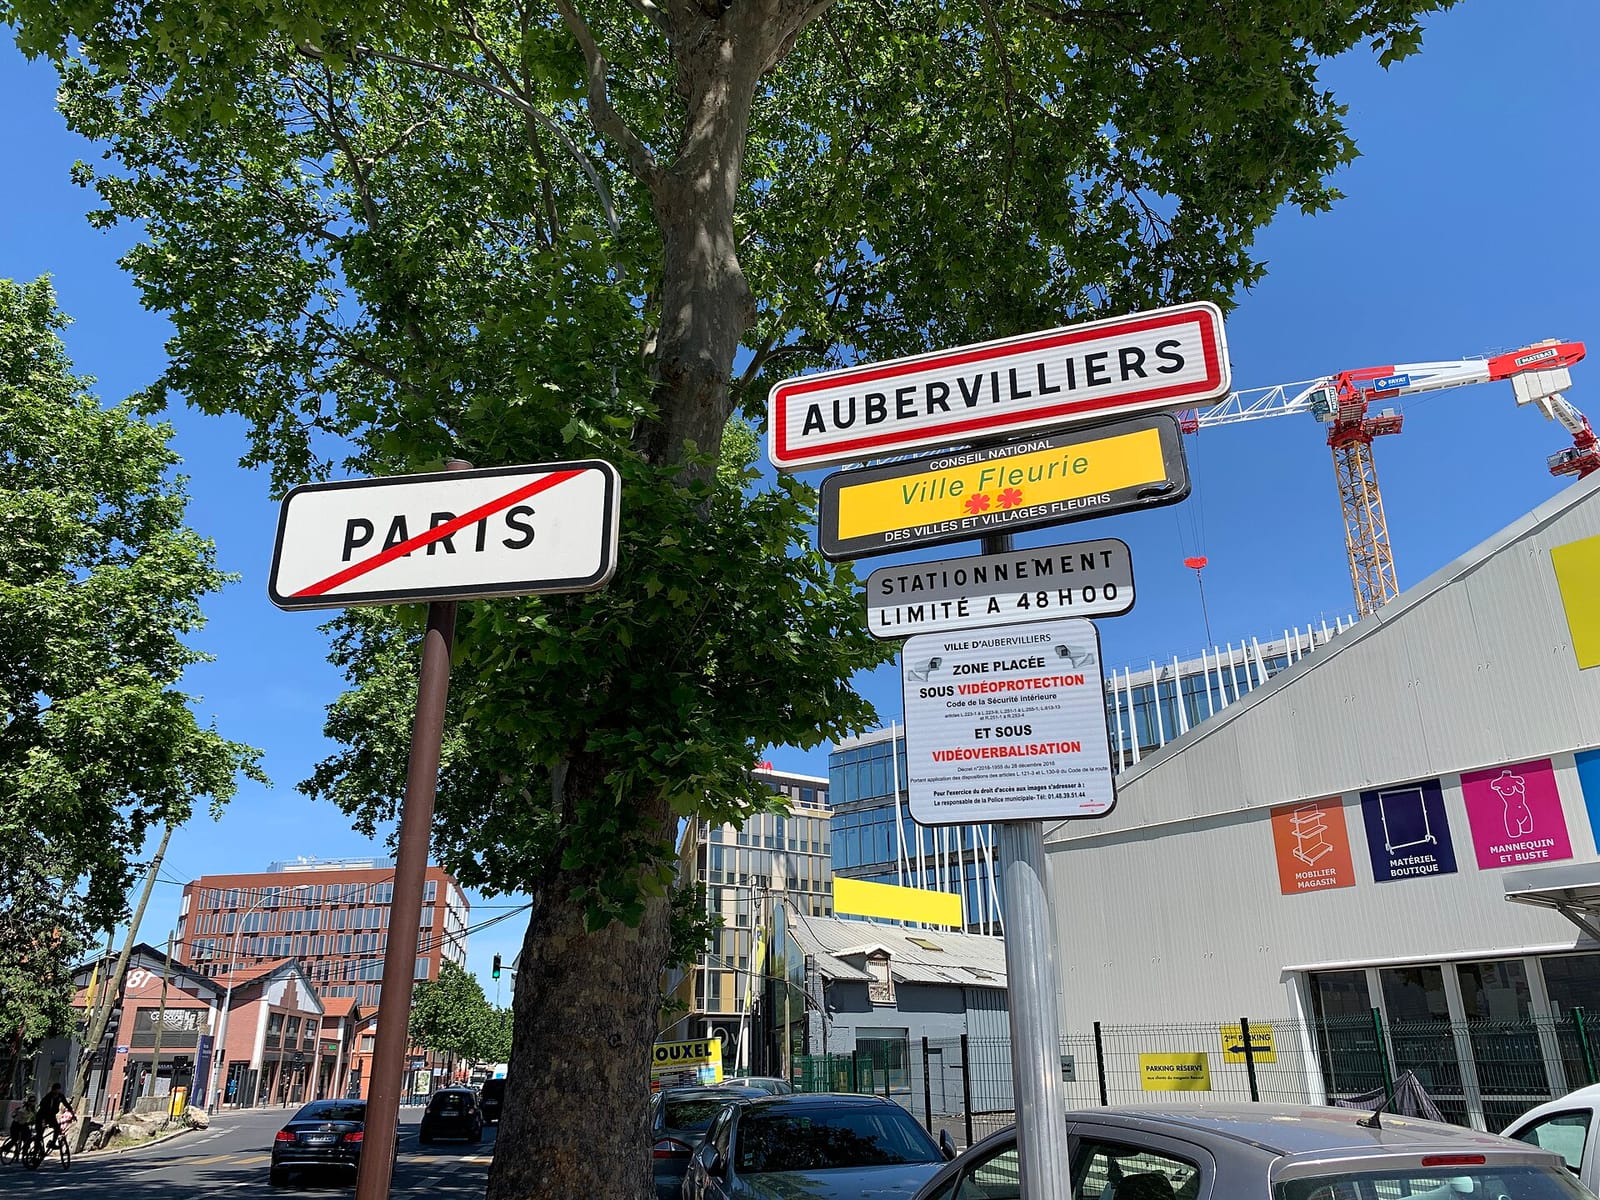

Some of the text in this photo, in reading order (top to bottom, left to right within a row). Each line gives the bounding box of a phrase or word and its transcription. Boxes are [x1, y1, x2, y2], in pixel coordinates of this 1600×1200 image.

[801, 339, 1185, 436] AUBERVILLIERS
[929, 438, 1053, 470] CONSEIL NATIONAL
[902, 450, 1088, 506] Ville Fleurie
[884, 493, 1110, 541] DES VILLES ET VILLAGES FLEURIS
[341, 505, 535, 562] PARIS
[881, 550, 1112, 595] STATIONNEMENT
[881, 582, 1117, 626] LIMITÉ A 48H00
[944, 633, 1051, 651] VILLE D'AUBERVILLIERS
[952, 655, 1045, 675] ZONE PLACÉE
[919, 673, 1084, 698] SOUS VIDÉOPROTECTION
[946, 699, 965, 707] Code
[978, 697, 985, 705] la
[987, 695, 1018, 704] Sécurité
[974, 725, 1032, 738] ET SOUS
[932, 741, 1081, 762] VIDÉOVERBALISATION
[926, 775, 951, 783] application
[961, 773, 988, 781] dispositions
[1026, 784, 1046, 792] images
[941, 798, 972, 807] responsable
[1489, 838, 1554, 854] MANNEQUIN
[1389, 854, 1436, 867] MATÉRIEL
[1499, 849, 1549, 863] ET BUSTE
[1295, 868, 1336, 880] MOBILIER
[1390, 863, 1438, 877] BOUTIQUE
[1297, 876, 1336, 888] MAGASIN
[1238, 1033, 1271, 1041] PKING
[654, 1043, 712, 1061] OUXEL
[1175, 1063, 1202, 1072] RÉSERVÉ
